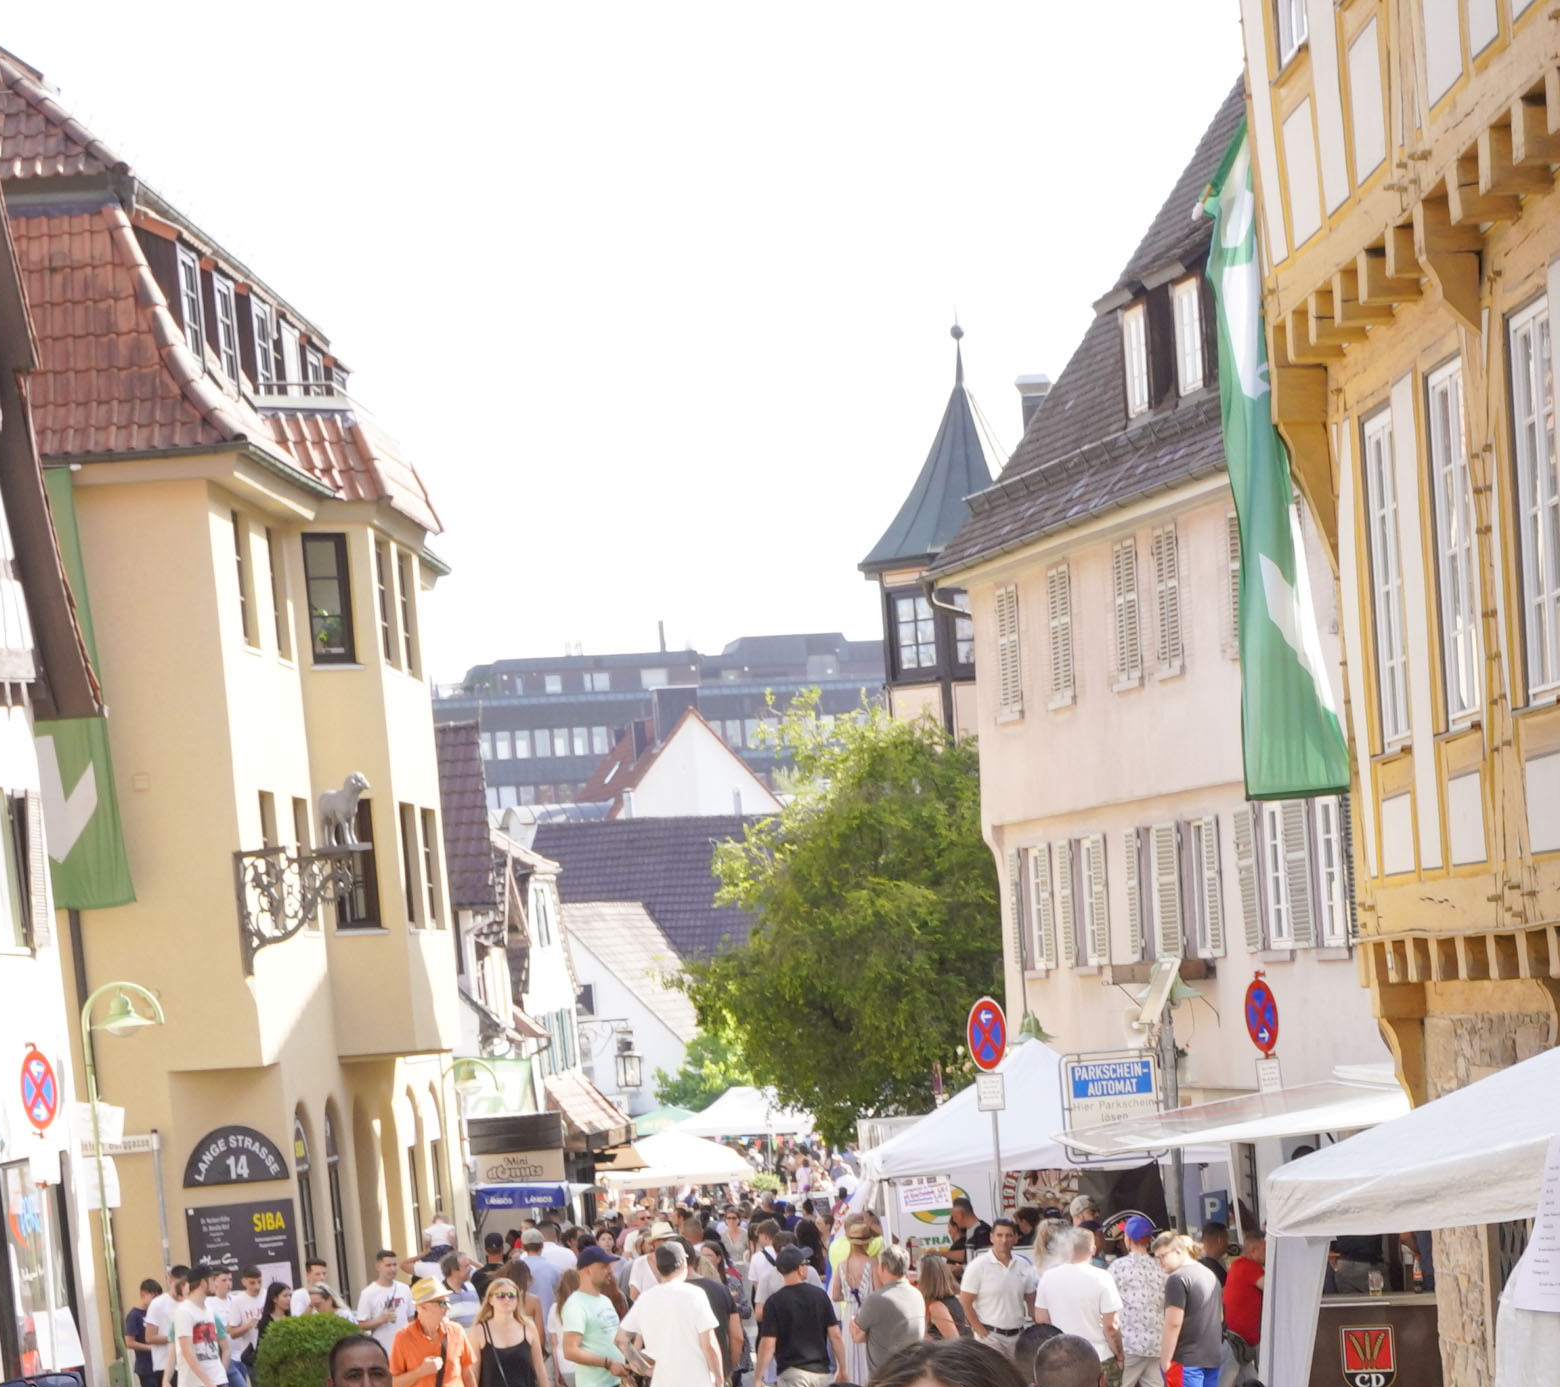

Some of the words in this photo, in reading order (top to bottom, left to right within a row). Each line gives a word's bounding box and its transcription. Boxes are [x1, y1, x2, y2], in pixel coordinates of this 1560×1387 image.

[1074, 1062, 1149, 1081] PARKSCHEIN-
[1088, 1078, 1137, 1097] AUTOMAT
[194, 1138, 227, 1183] LANGE
[229, 1135, 281, 1176] STRASSE
[226, 1154, 250, 1180] 14
[503, 1156, 528, 1167] Mini
[1204, 1197, 1221, 1220] P
[252, 1211, 286, 1232] SIBA
